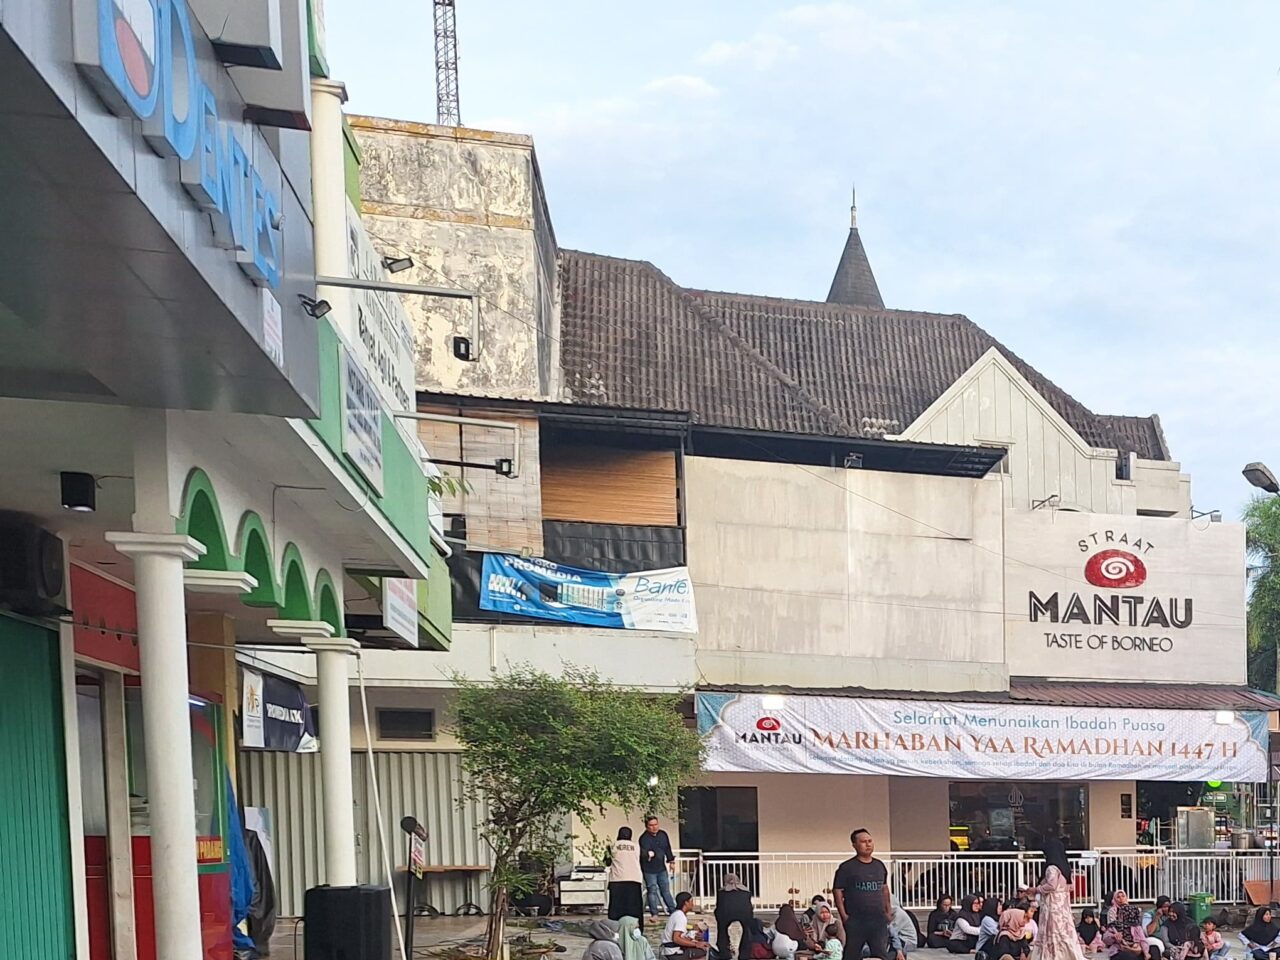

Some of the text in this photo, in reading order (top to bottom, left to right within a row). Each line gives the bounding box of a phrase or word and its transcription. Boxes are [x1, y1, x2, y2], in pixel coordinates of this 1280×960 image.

[1078, 530, 1155, 555] STRAAT
[504, 558, 582, 583] PROMEDIA
[635, 576, 689, 595] Bante
[1029, 590, 1193, 629] MANTAU
[1044, 633, 1173, 652] TASTE OF BORNEO
[893, 710, 1165, 732] Selamat Menunaikan Ibadah Puasa
[735, 732, 802, 745] MANTAU
[809, 727, 1238, 760] MARHABAN YAA RAMADHAN 1447 H
